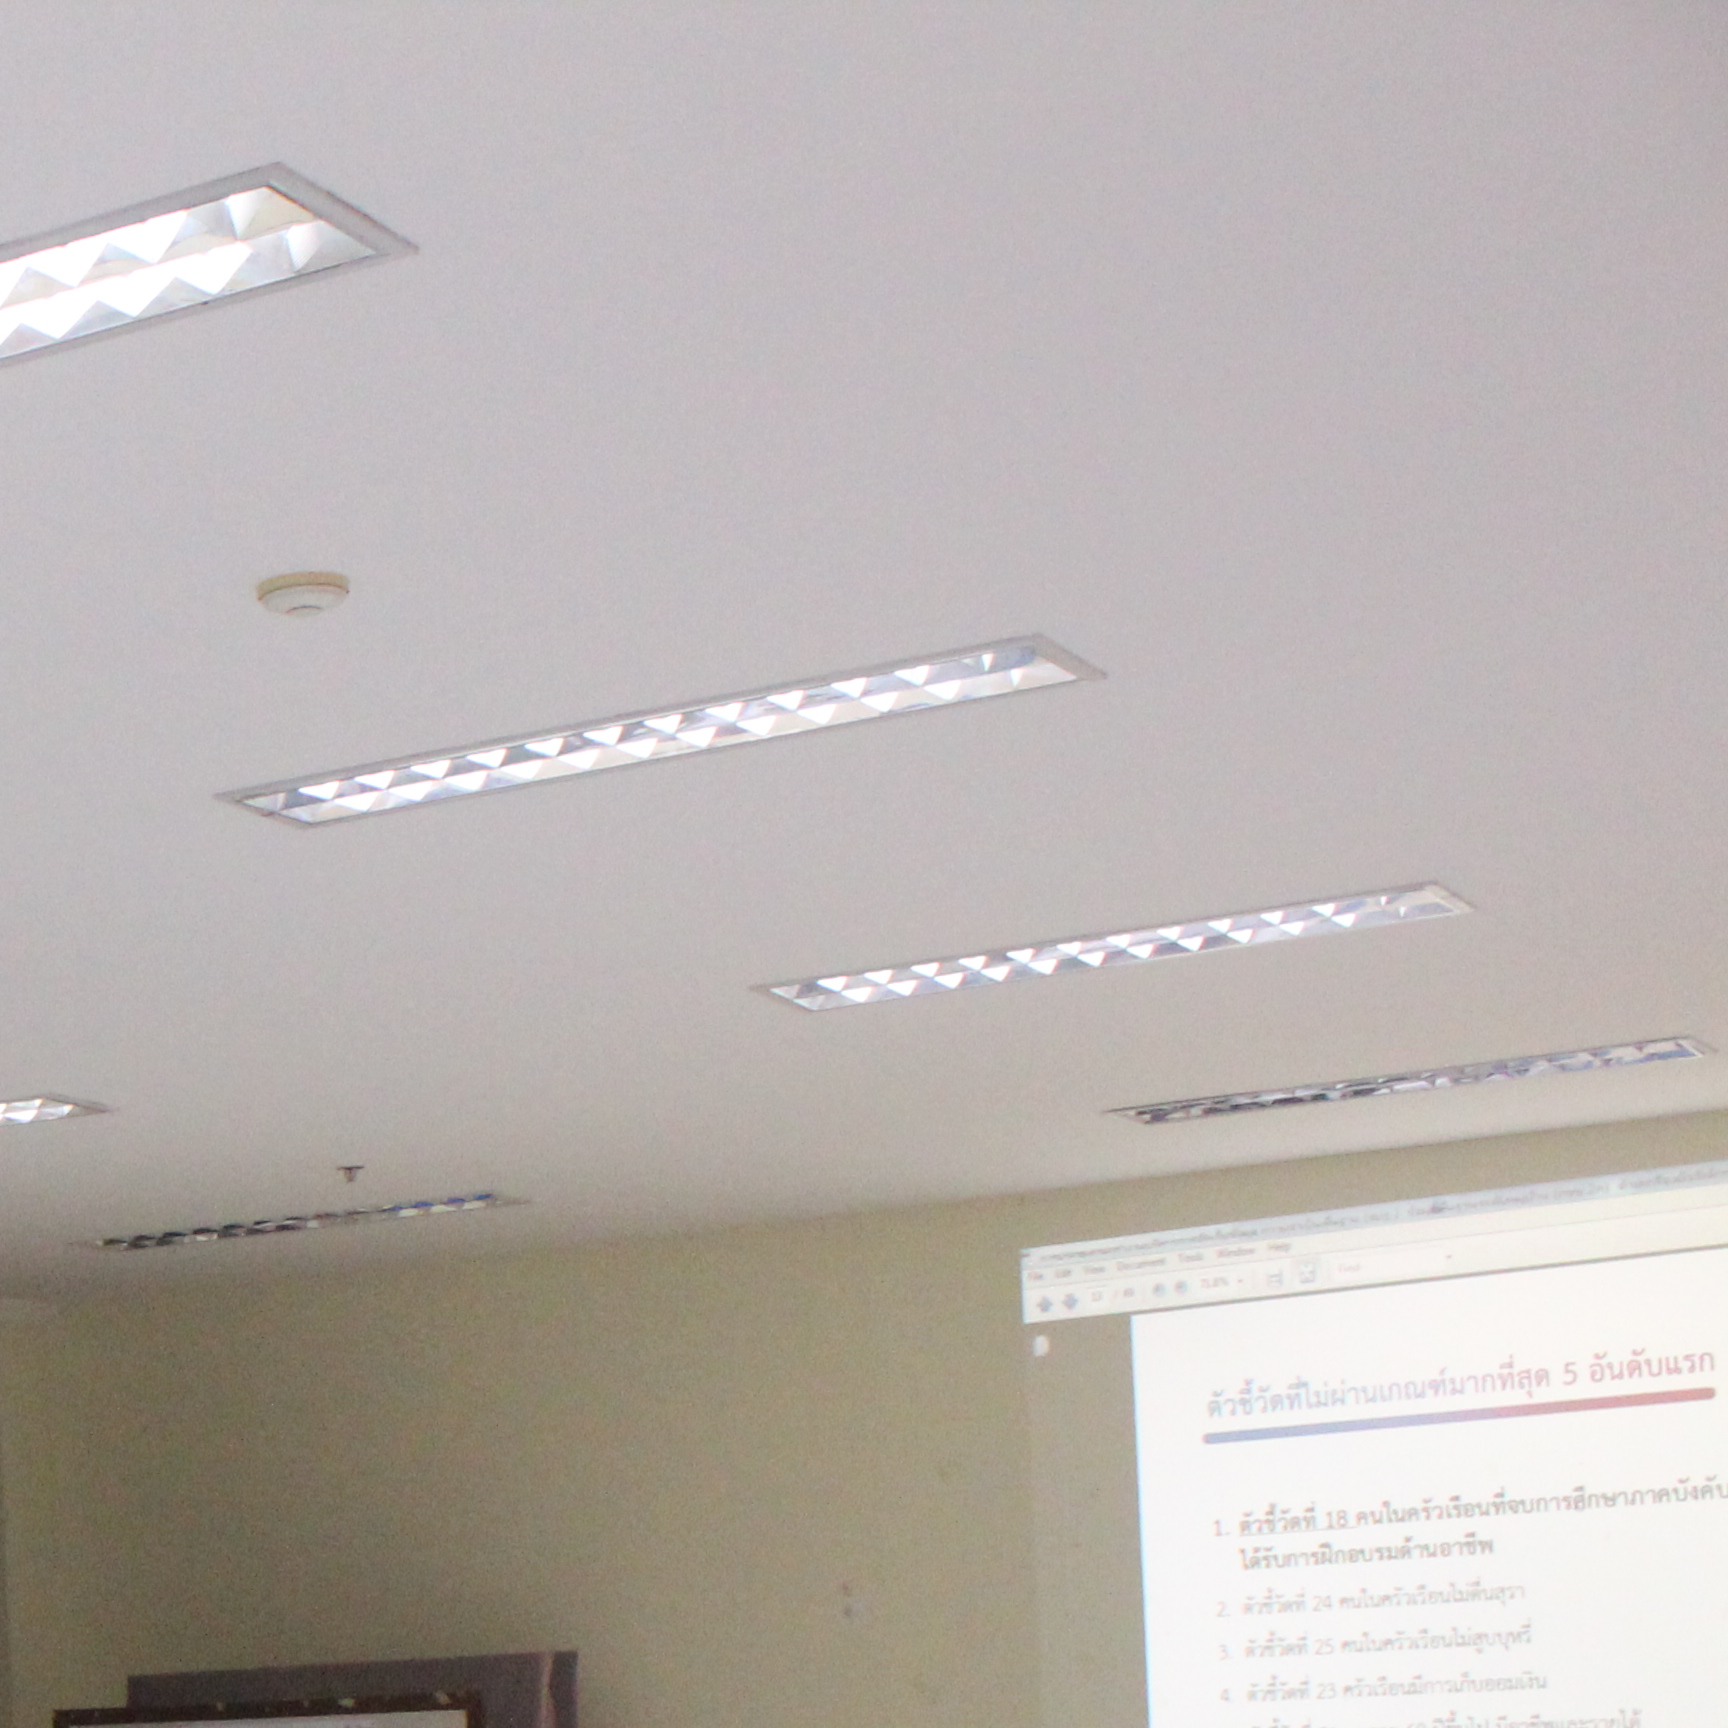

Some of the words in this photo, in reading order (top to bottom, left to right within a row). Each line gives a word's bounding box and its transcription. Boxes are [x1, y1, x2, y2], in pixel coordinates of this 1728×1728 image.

[1561, 1362, 1578, 1386] 5
[1590, 1349, 1715, 1383] อันดับแรก
[1212, 1518, 1231, 1538] 1.
[1325, 1510, 1348, 1530] 18
[1312, 1595, 1333, 1611] 24
[1314, 1638, 1333, 1655] 25
[1315, 1682, 1336, 1699] 23
